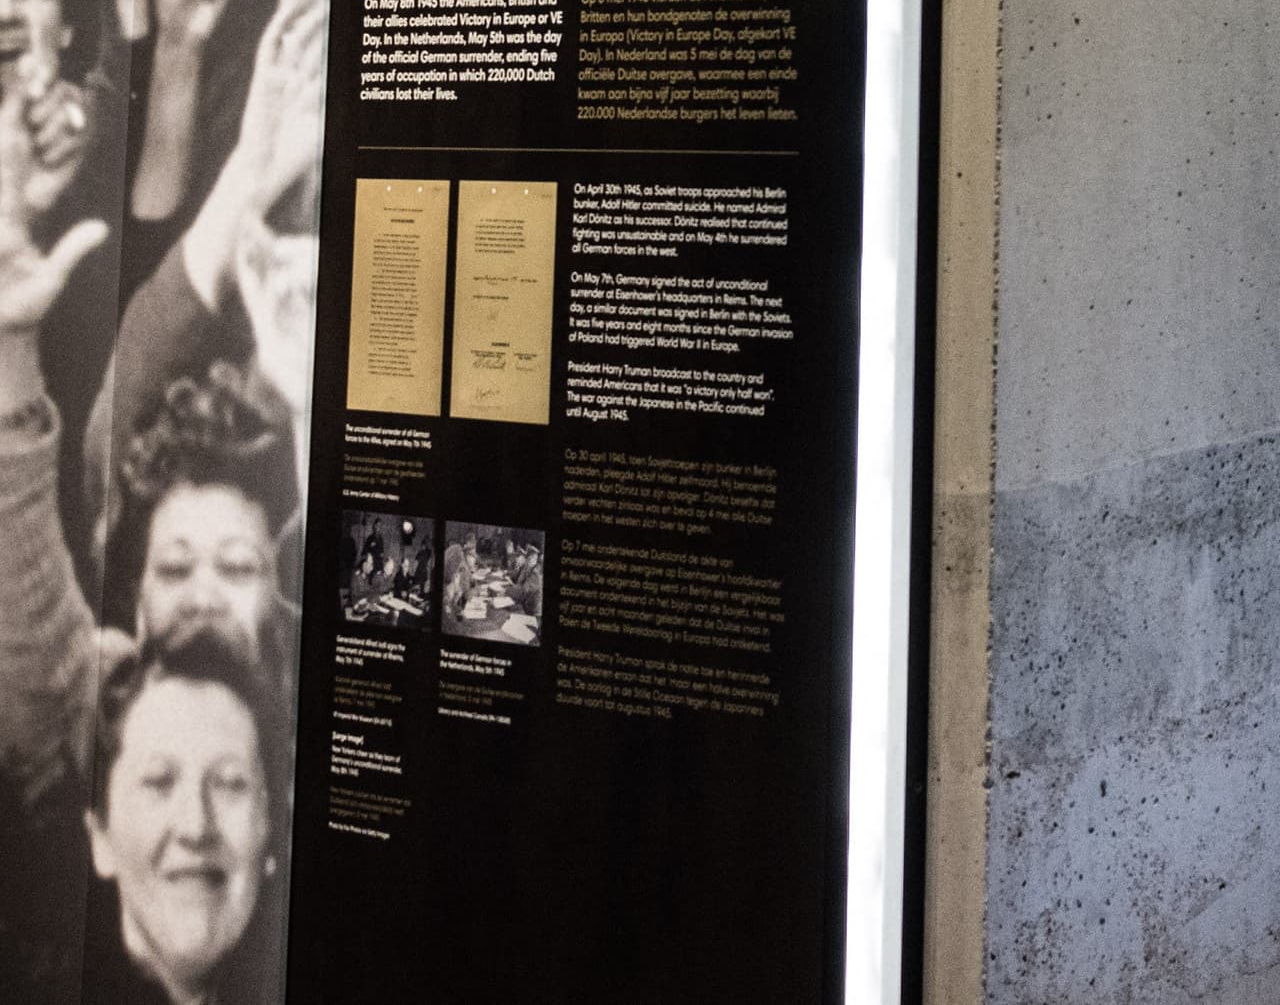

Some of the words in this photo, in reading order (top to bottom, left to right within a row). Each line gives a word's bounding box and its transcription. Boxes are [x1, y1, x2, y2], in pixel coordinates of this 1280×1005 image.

[363, 15, 384, 27] their
[385, 14, 408, 27] allies
[409, 13, 458, 26] celebrated
[459, 13, 492, 28] Victory
[492, 12, 502, 24] in
[503, 12, 536, 27] Europe
[537, 14, 548, 24] or
[550, 11, 563, 24] VE
[363, 33, 382, 48] Day.
[383, 33, 392, 44] In
[394, 32, 408, 45] the
[410, 31, 466, 45] Netherlands,
[468, 31, 488, 47] May
[489, 30, 504, 44] 5th
[506, 34, 524, 43] was
[526, 30, 542, 43] the
[543, 30, 562, 46] day
[362, 50, 372, 63] of
[372, 51, 387, 63] the
[388, 50, 419, 63] official
[420, 50, 457, 63] German
[459, 49, 504, 63] surrender,
[506, 49, 539, 66] ending
[540, 48, 557, 62] five
[361, 72, 384, 85] years
[385, 68, 396, 81] of
[396, 69, 447, 84] occupation
[448, 68, 457, 81] in
[459, 68, 486, 81] which
[487, 68, 525, 82] 220,000
[526, 68, 555, 81] Dutch
[360, 87, 394, 100] civilians
[395, 87, 412, 100] lost
[413, 87, 434, 100] their
[435, 87, 457, 100] lives.
